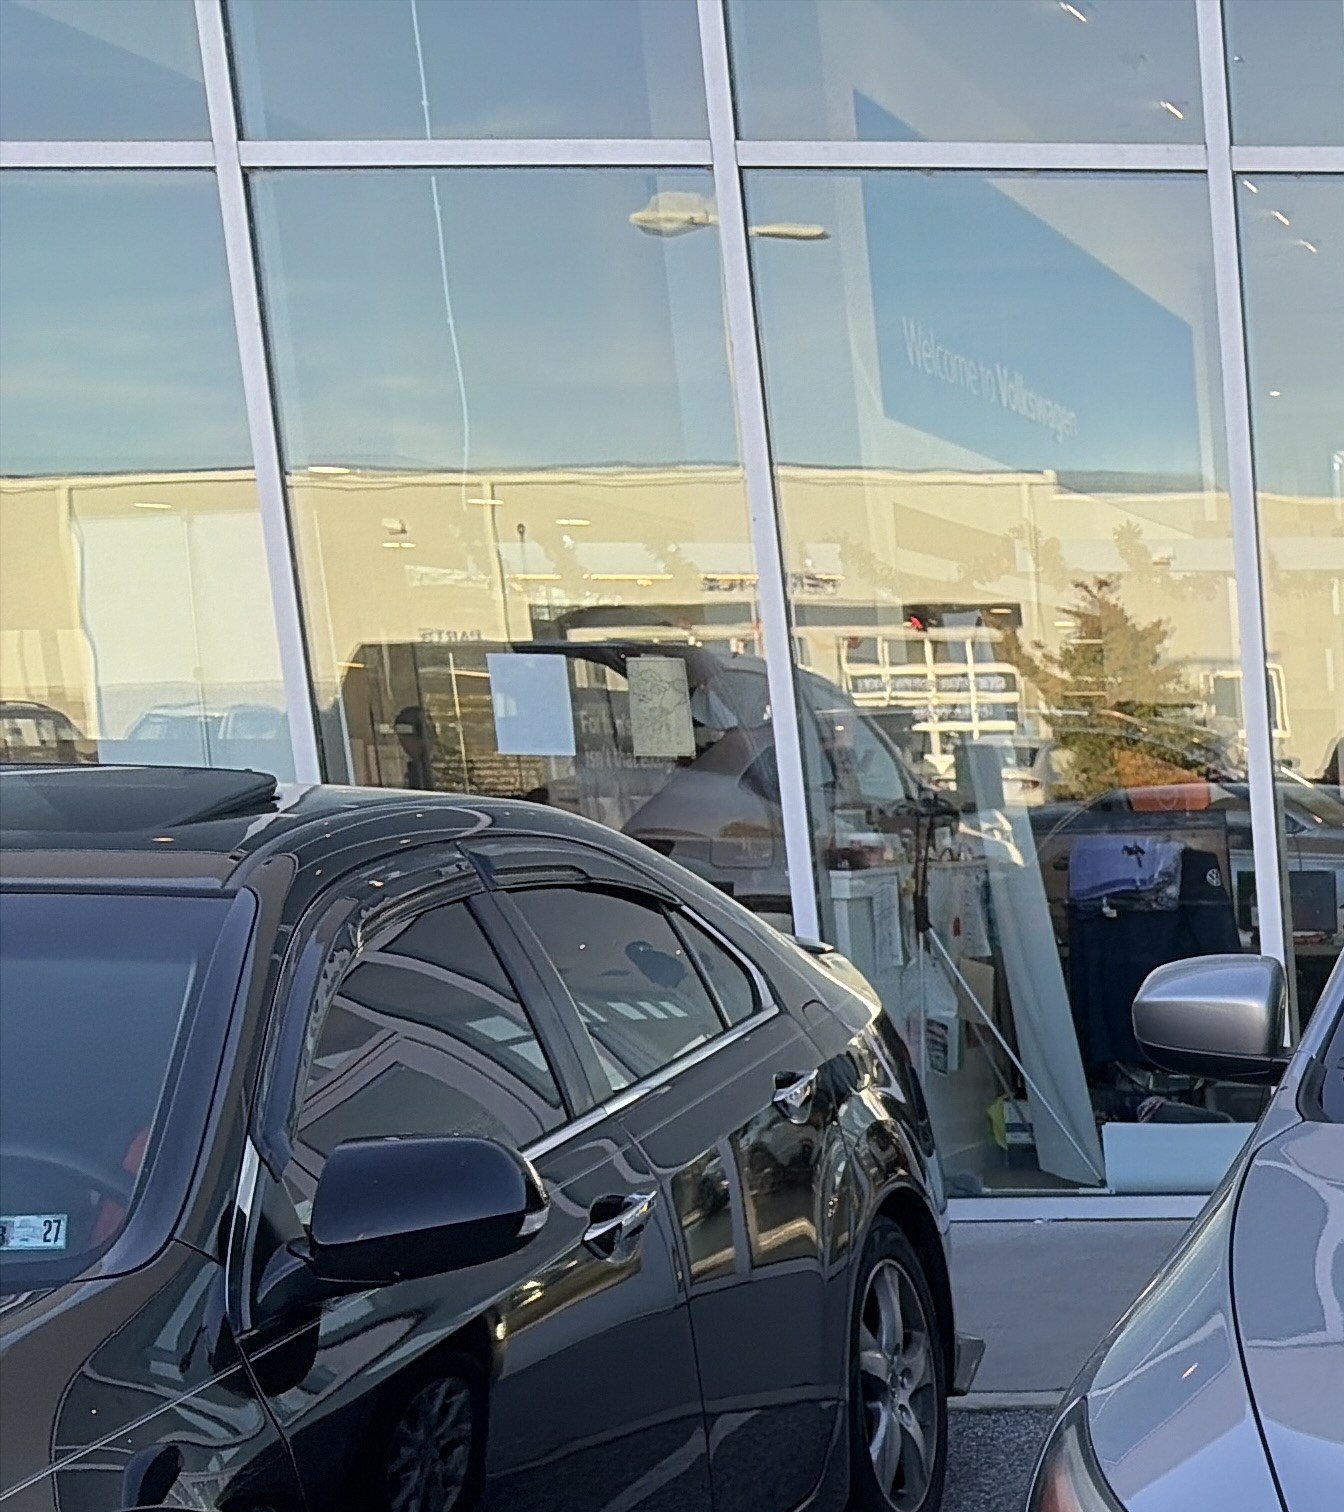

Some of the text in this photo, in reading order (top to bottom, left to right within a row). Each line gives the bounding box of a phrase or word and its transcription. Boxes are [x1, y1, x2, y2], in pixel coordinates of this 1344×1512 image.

[902, 316, 978, 395] Welcome
[995, 363, 1079, 444] Volkswagen
[42, 1219, 62, 1243] 27
